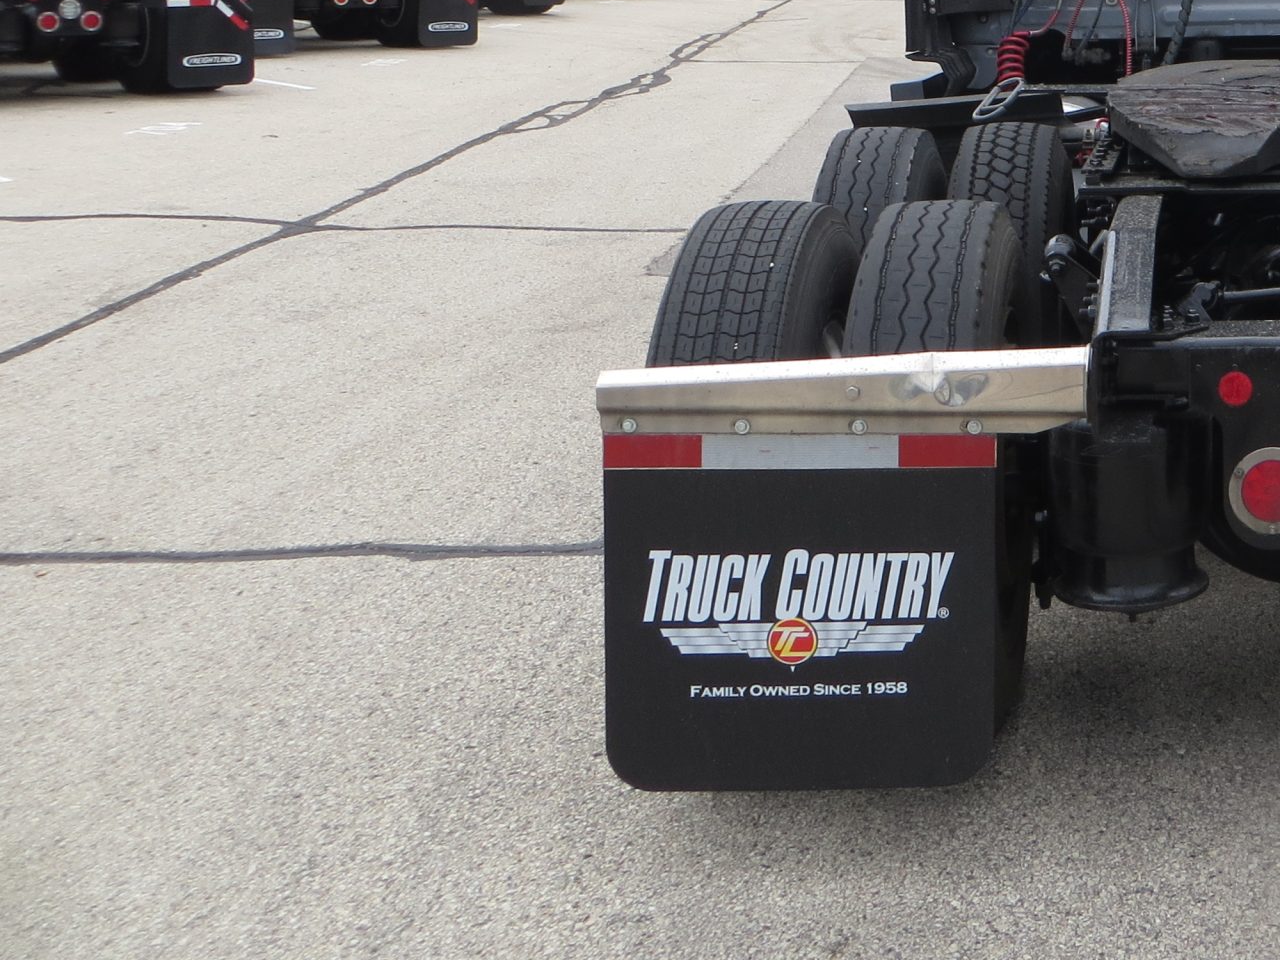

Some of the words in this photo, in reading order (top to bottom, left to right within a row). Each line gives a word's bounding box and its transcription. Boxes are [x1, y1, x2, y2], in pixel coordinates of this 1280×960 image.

[643, 550, 772, 622] TRUCK
[772, 626, 812, 657] TC
[690, 685, 748, 698] FAMILY
[750, 684, 811, 697] OWNED
[813, 683, 862, 696] SINCE
[866, 681, 908, 695] 1958
